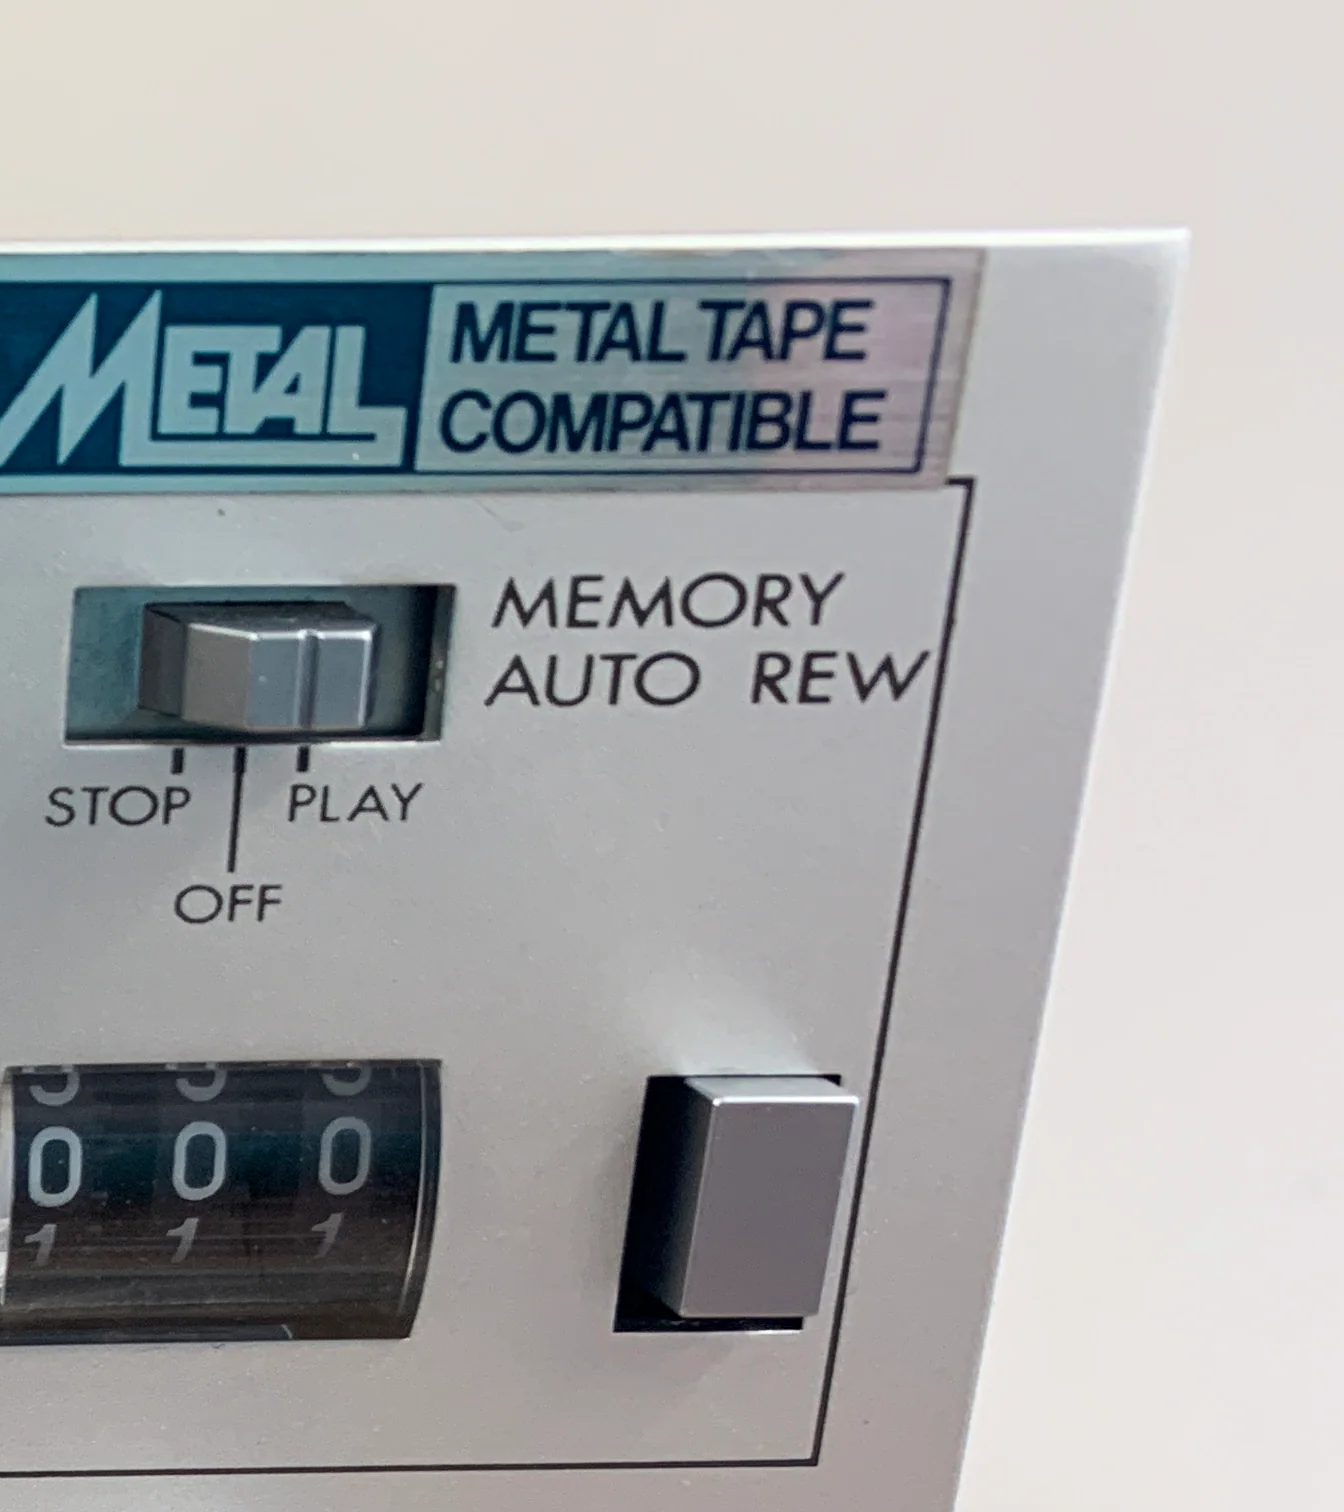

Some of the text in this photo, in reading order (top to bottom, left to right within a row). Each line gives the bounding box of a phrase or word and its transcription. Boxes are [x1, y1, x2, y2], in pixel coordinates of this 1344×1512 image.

[448, 298, 876, 366] METAL TAPE
[436, 386, 888, 456] COMPATIBLE
[490, 570, 848, 632] MEMORY
[484, 648, 932, 708] AUTO REW
[42, 784, 194, 830] STOP
[286, 782, 426, 824] PLAY
[172, 882, 284, 926] OFF
